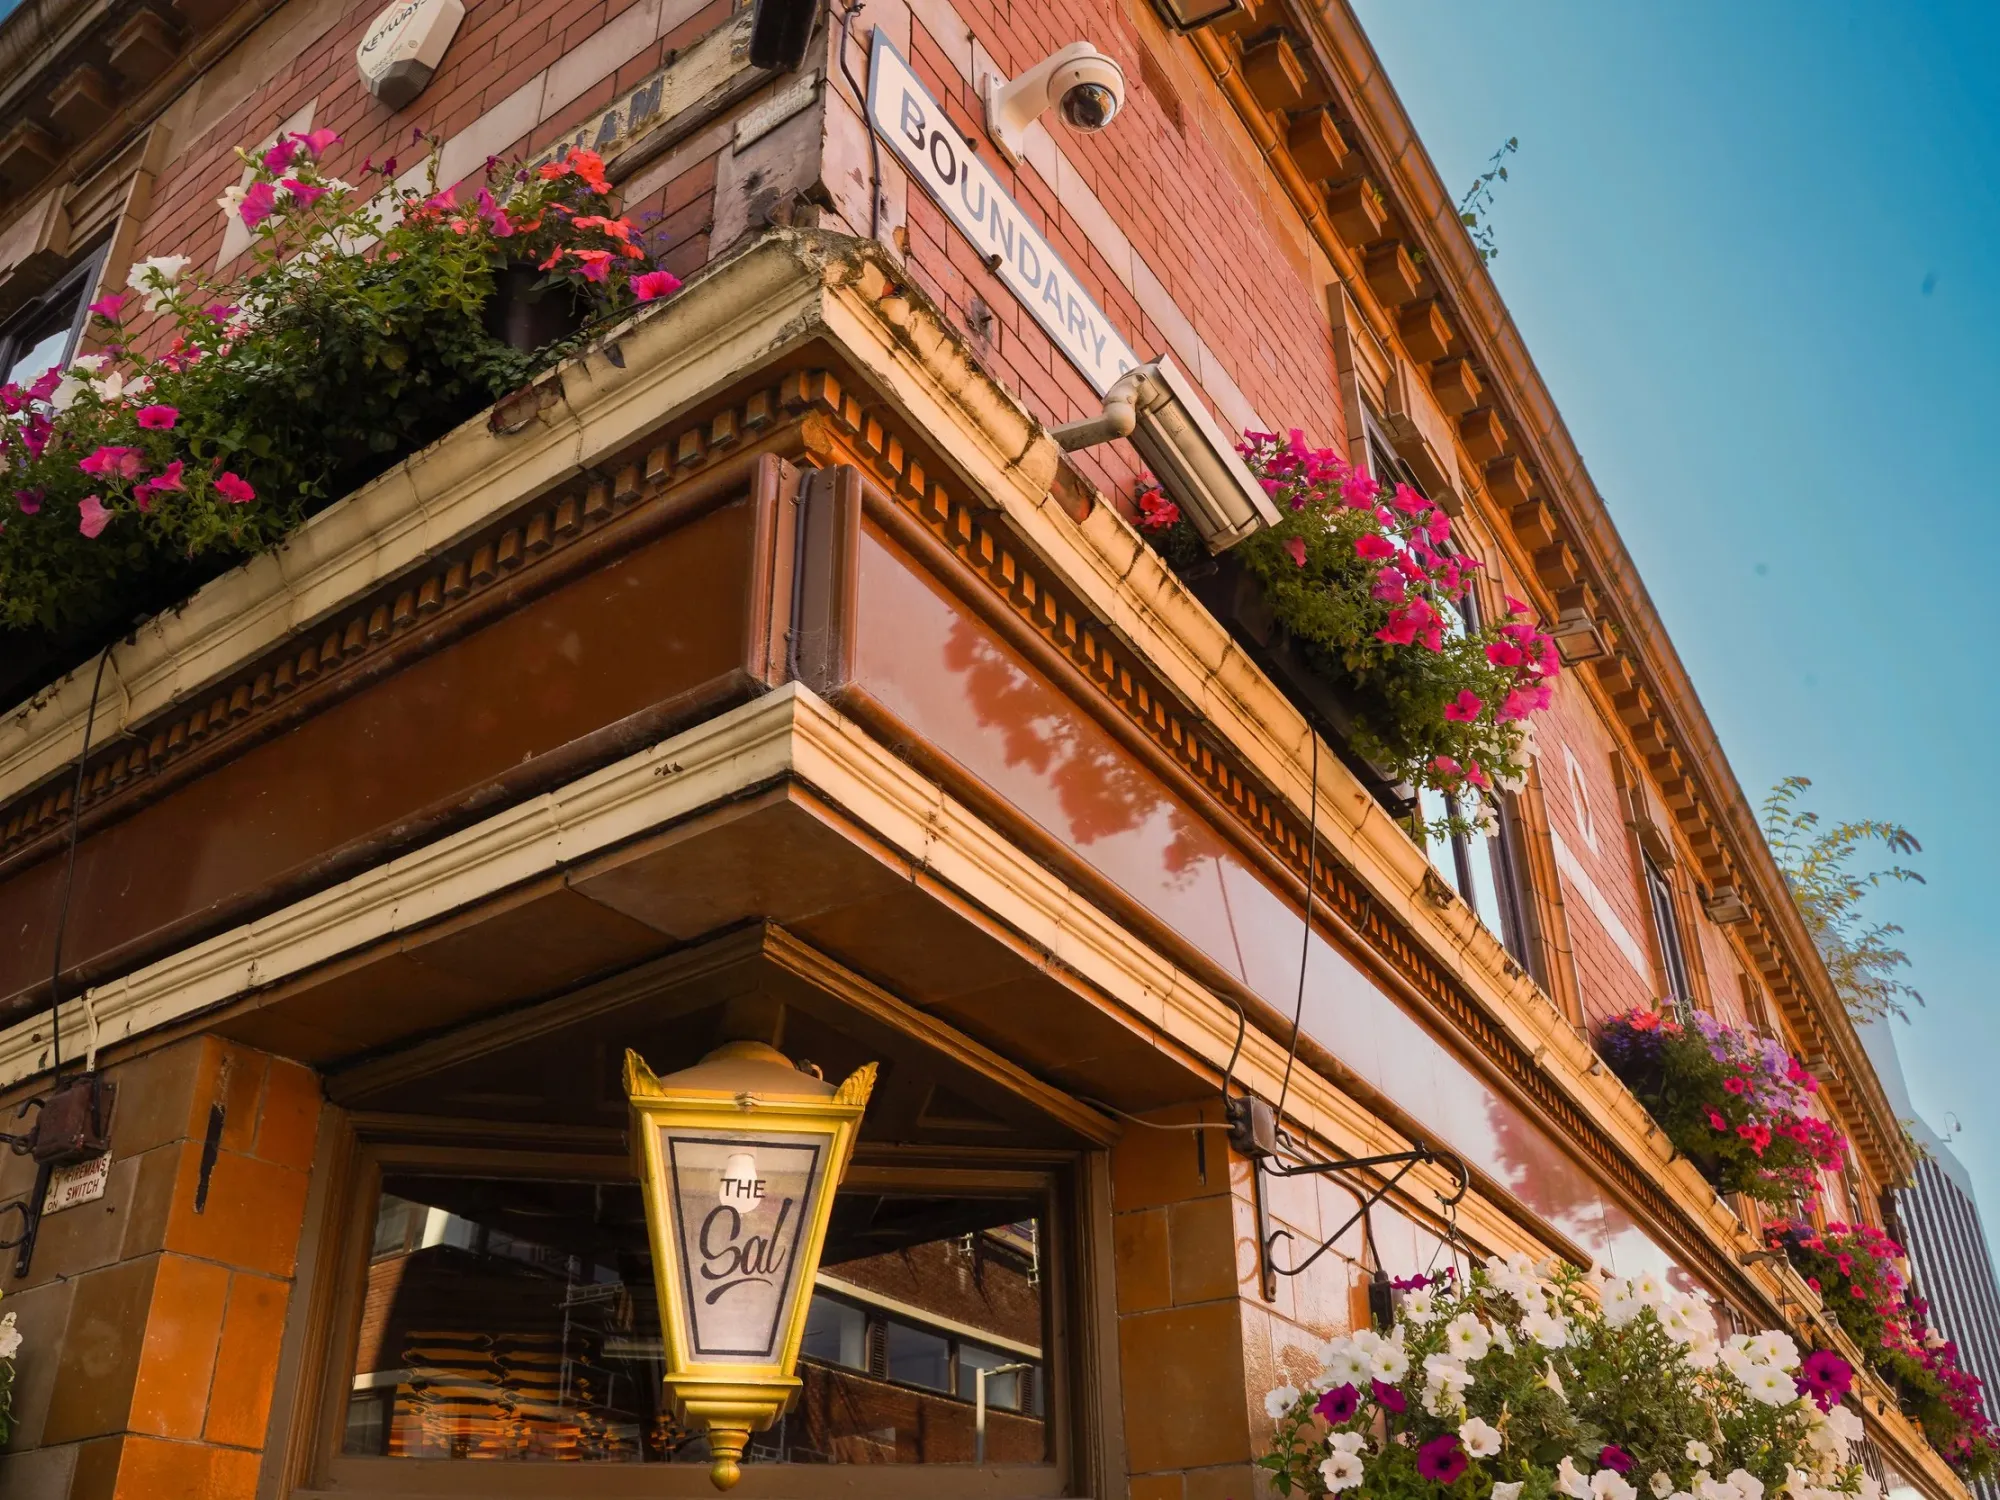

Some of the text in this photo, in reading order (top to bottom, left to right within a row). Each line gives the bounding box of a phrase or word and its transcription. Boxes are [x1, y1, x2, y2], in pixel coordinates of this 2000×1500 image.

[742, 79, 808, 130] DANGER
[900, 86, 1107, 367] BOUNDARY
[47, 1199, 59, 1212] ON
[65, 1179, 100, 1202] SWITCH
[720, 1178, 767, 1199] THE
[699, 1197, 793, 1281] Sal
